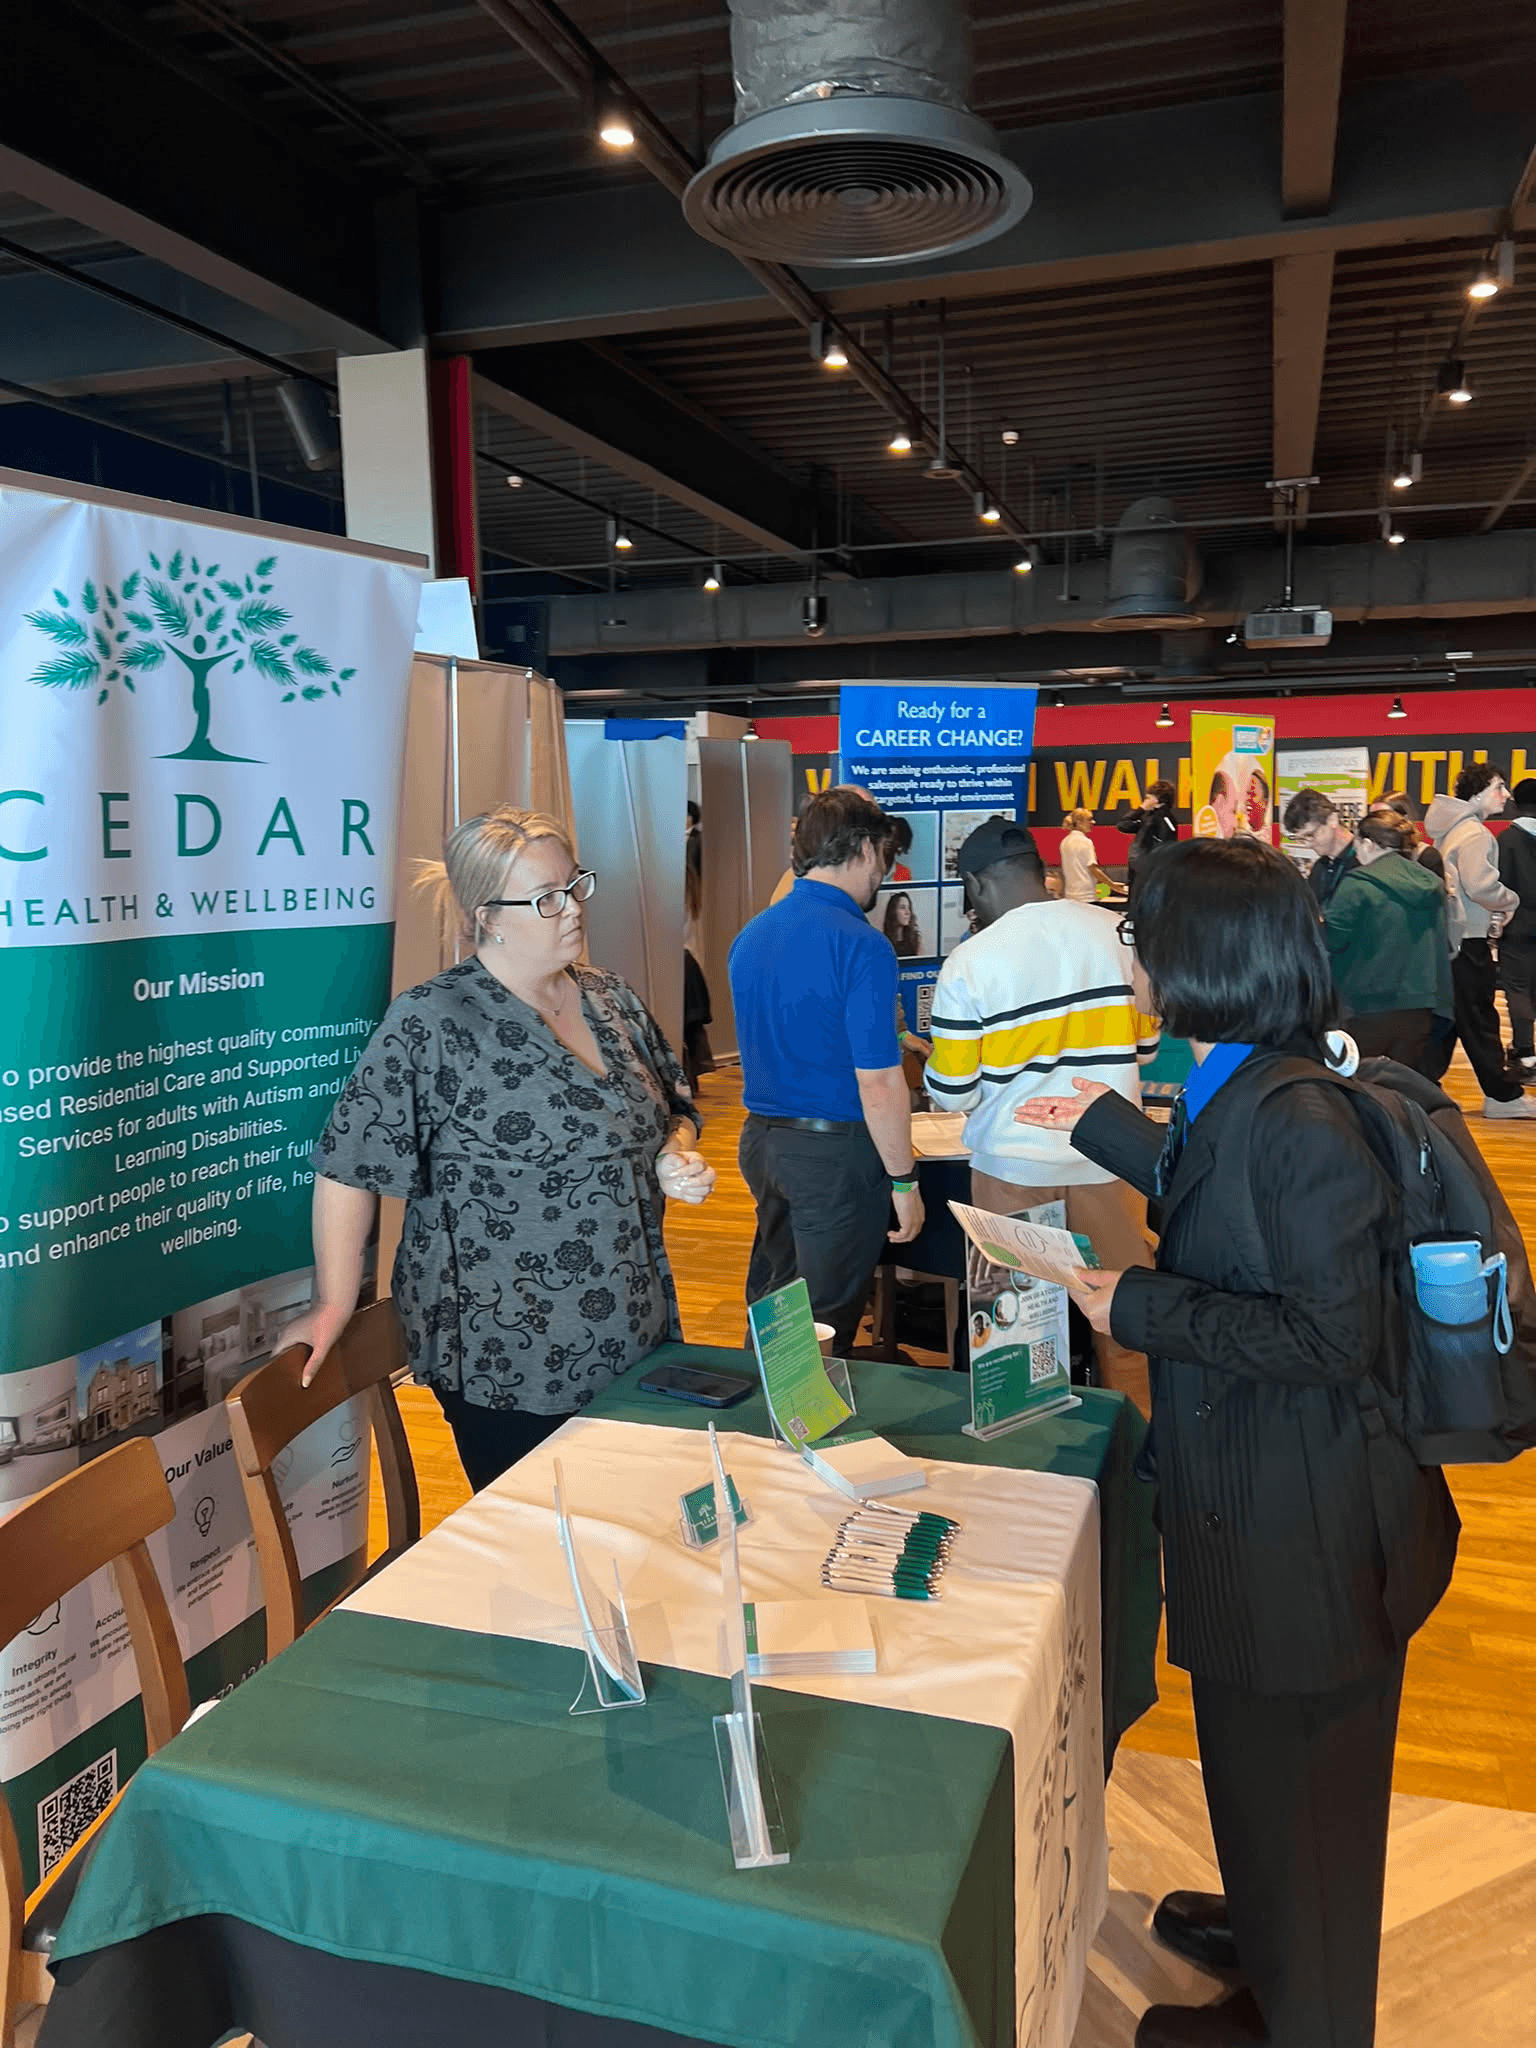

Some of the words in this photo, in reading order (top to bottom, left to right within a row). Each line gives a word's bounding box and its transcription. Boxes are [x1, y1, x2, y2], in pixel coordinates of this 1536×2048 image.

[897, 700, 946, 723] Ready
[950, 700, 973, 719] for
[977, 706, 986, 719] a
[855, 729, 932, 747] CAREER
[936, 729, 1024, 747] CHANGE?
[851, 764, 870, 775] We
[871, 767, 888, 775] are
[888, 764, 921, 777] seeking
[922, 764, 975, 776] enthusiastic,
[976, 763, 1026, 776] professional
[868, 779, 919, 791] salespeople
[920, 778, 946, 791] ready
[946, 779, 957, 788] to
[958, 778, 984, 788] thrive
[985, 777, 1013, 788] within
[914, 792, 960, 805] fast-paced
[960, 792, 1015, 802] environment
[0, 789, 376, 862] CEDAR
[0, 893, 139, 928] HEALTH
[155, 893, 174, 918] &
[190, 886, 376, 915] WELLBEING
[133, 978, 174, 1001] Our
[178, 968, 265, 996] Mission
[28, 1055, 113, 1090] provide
[116, 1050, 144, 1071] the
[147, 1036, 213, 1065] highest
[217, 1028, 277, 1055] quality
[281, 1017, 379, 1043] community-
[0, 1098, 52, 1124] sed
[60, 1077, 159, 1117] Residential
[163, 1073, 206, 1093] Care
[210, 1062, 243, 1085] and
[247, 1049, 339, 1078] Supported
[18, 1129, 113, 1158] Services
[117, 1118, 142, 1138] for
[146, 1105, 198, 1130] adults
[202, 1094, 239, 1117] with
[243, 1086, 304, 1109] Autism
[115, 1140, 187, 1173] Learning
[191, 1118, 288, 1151] Disabilities.
[18, 1194, 105, 1230] support
[109, 1177, 166, 1213] people
[170, 1171, 187, 1188] to
[191, 1156, 239, 1182] reach
[243, 1146, 282, 1168] their
[286, 1139, 314, 1159] full
[48, 1222, 131, 1259] enhance
[135, 1205, 173, 1233] their
[176, 1190, 232, 1221] quality
[235, 1179, 253, 1201] of
[257, 1174, 287, 1195] life,
[160, 1218, 242, 1255] wellbeing.
[165, 1460, 192, 1484] Our
[194, 1438, 234, 1467] Value
[189, 1546, 221, 1571] Respect
[12, 1648, 58, 1677] Integrity
[0, 1700, 40, 1721] ommitted
